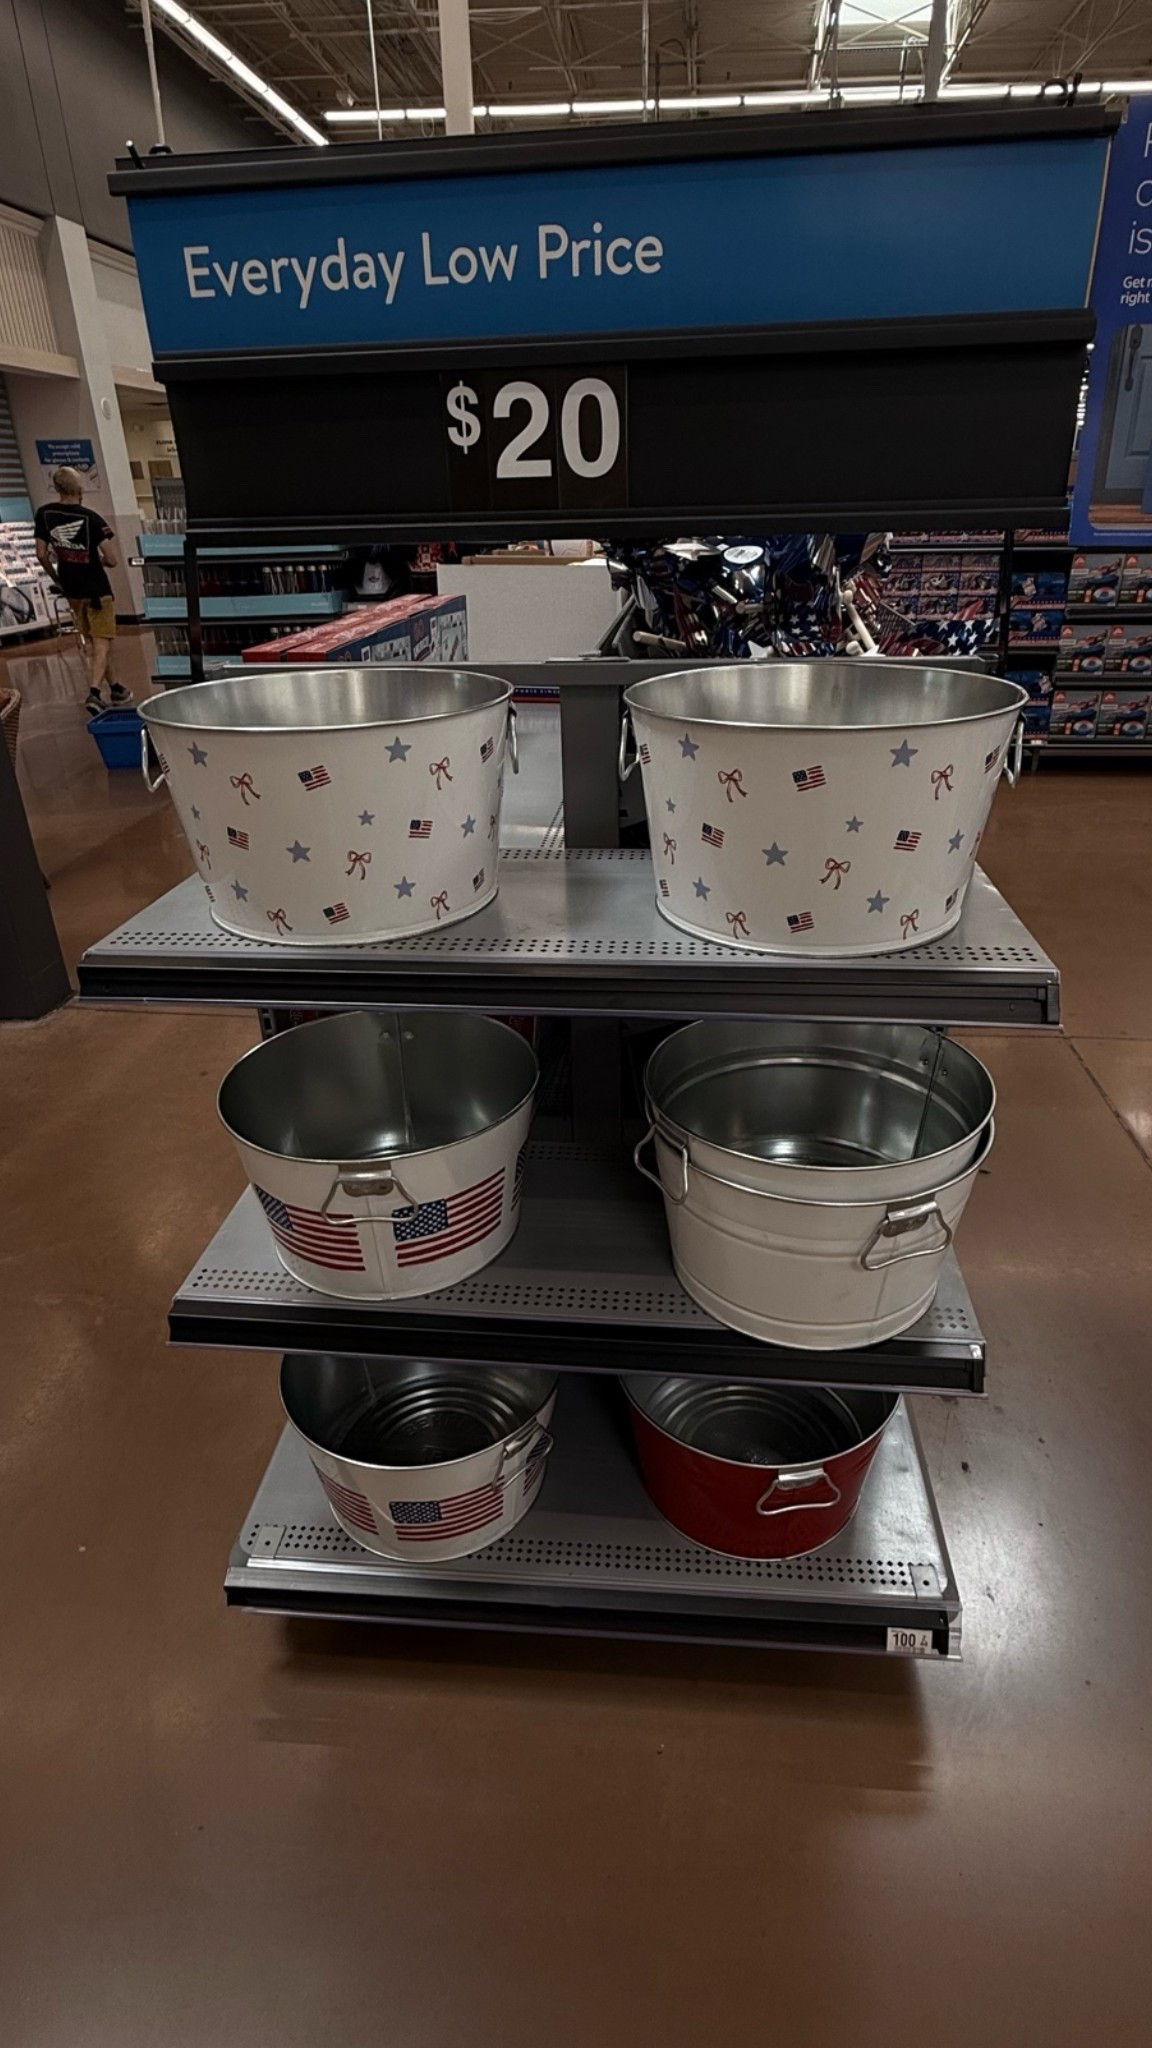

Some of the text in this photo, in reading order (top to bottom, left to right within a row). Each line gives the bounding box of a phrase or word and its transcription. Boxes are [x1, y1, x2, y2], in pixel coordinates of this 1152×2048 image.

[183, 222, 664, 309] Everyday Low Price
[1123, 276, 1145, 289] Get
[1120, 290, 1150, 307] right
[446, 377, 621, 479] $20
[892, 1633, 916, 1647] 100
